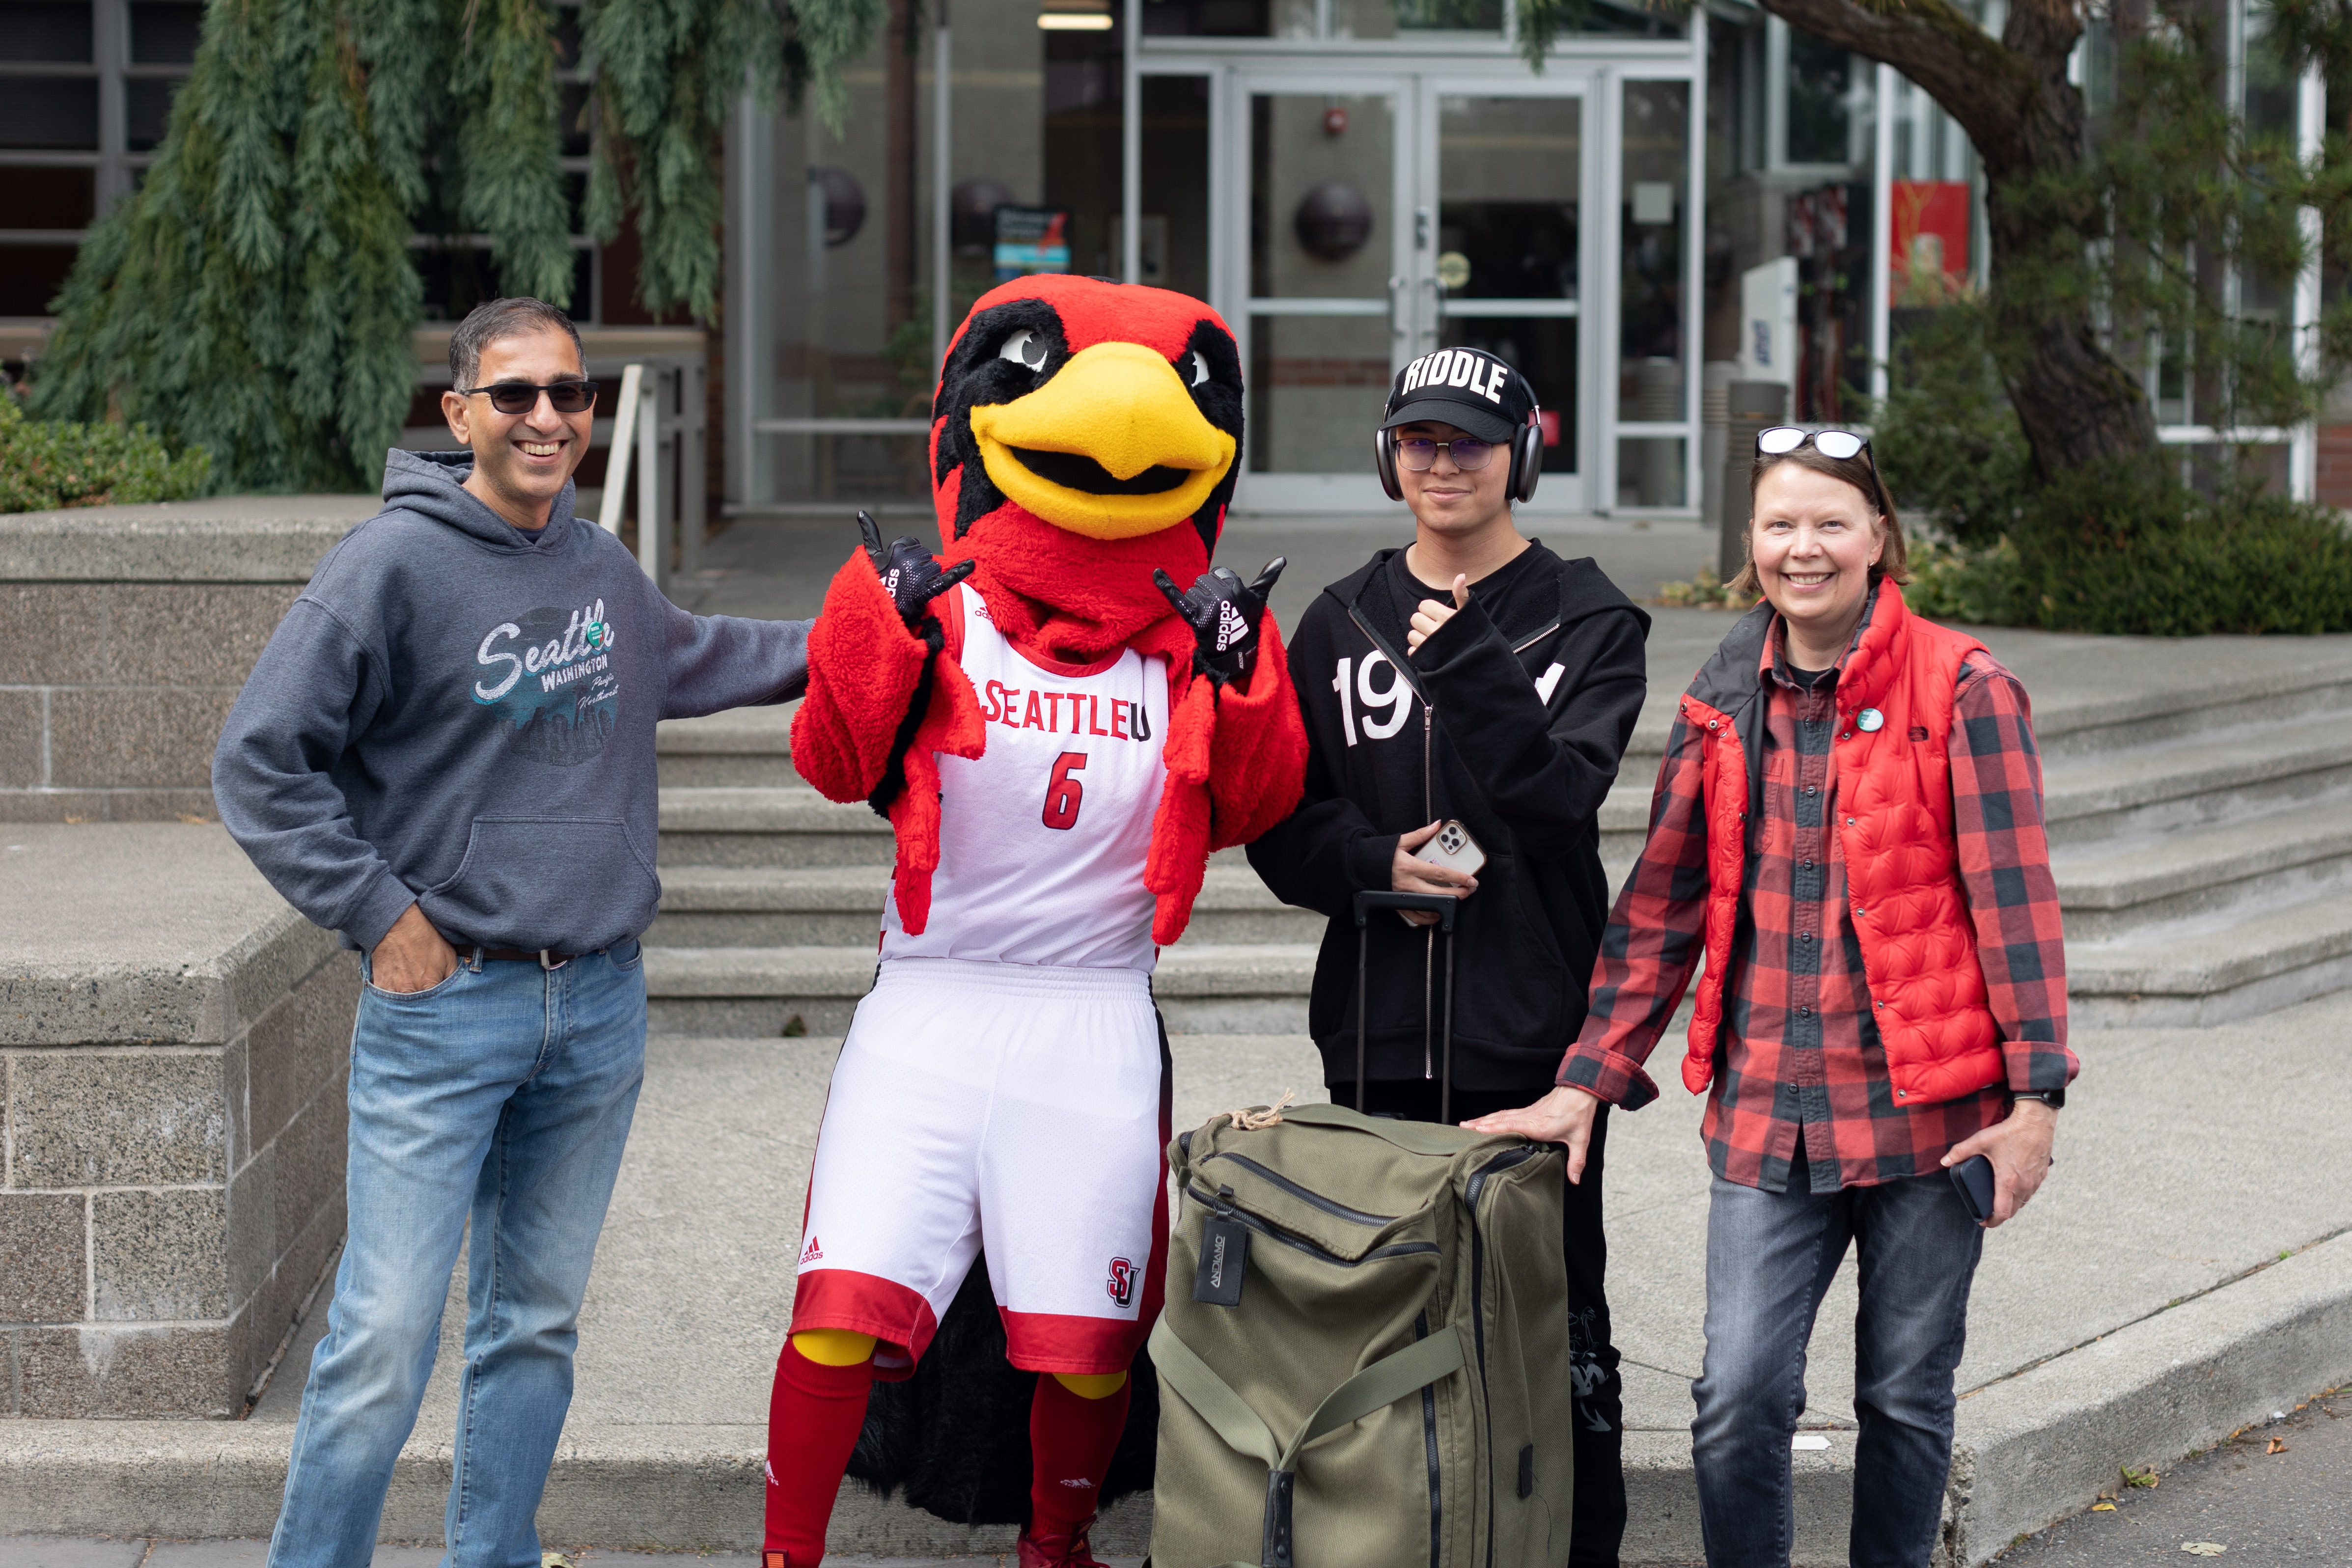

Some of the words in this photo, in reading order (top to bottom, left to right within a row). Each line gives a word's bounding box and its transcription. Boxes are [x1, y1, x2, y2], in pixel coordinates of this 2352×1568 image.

[474, 598, 614, 701] Seattle
[1217, 600, 1232, 652] adidas
[541, 654, 608, 693] WASHINGTON
[578, 684, 619, 710] Northwest
[1332, 649, 1413, 747] 19
[1042, 751, 1088, 830] 6
[800, 1251, 823, 1265] adidas
[1210, 1235, 1225, 1288] ANDIAMO
